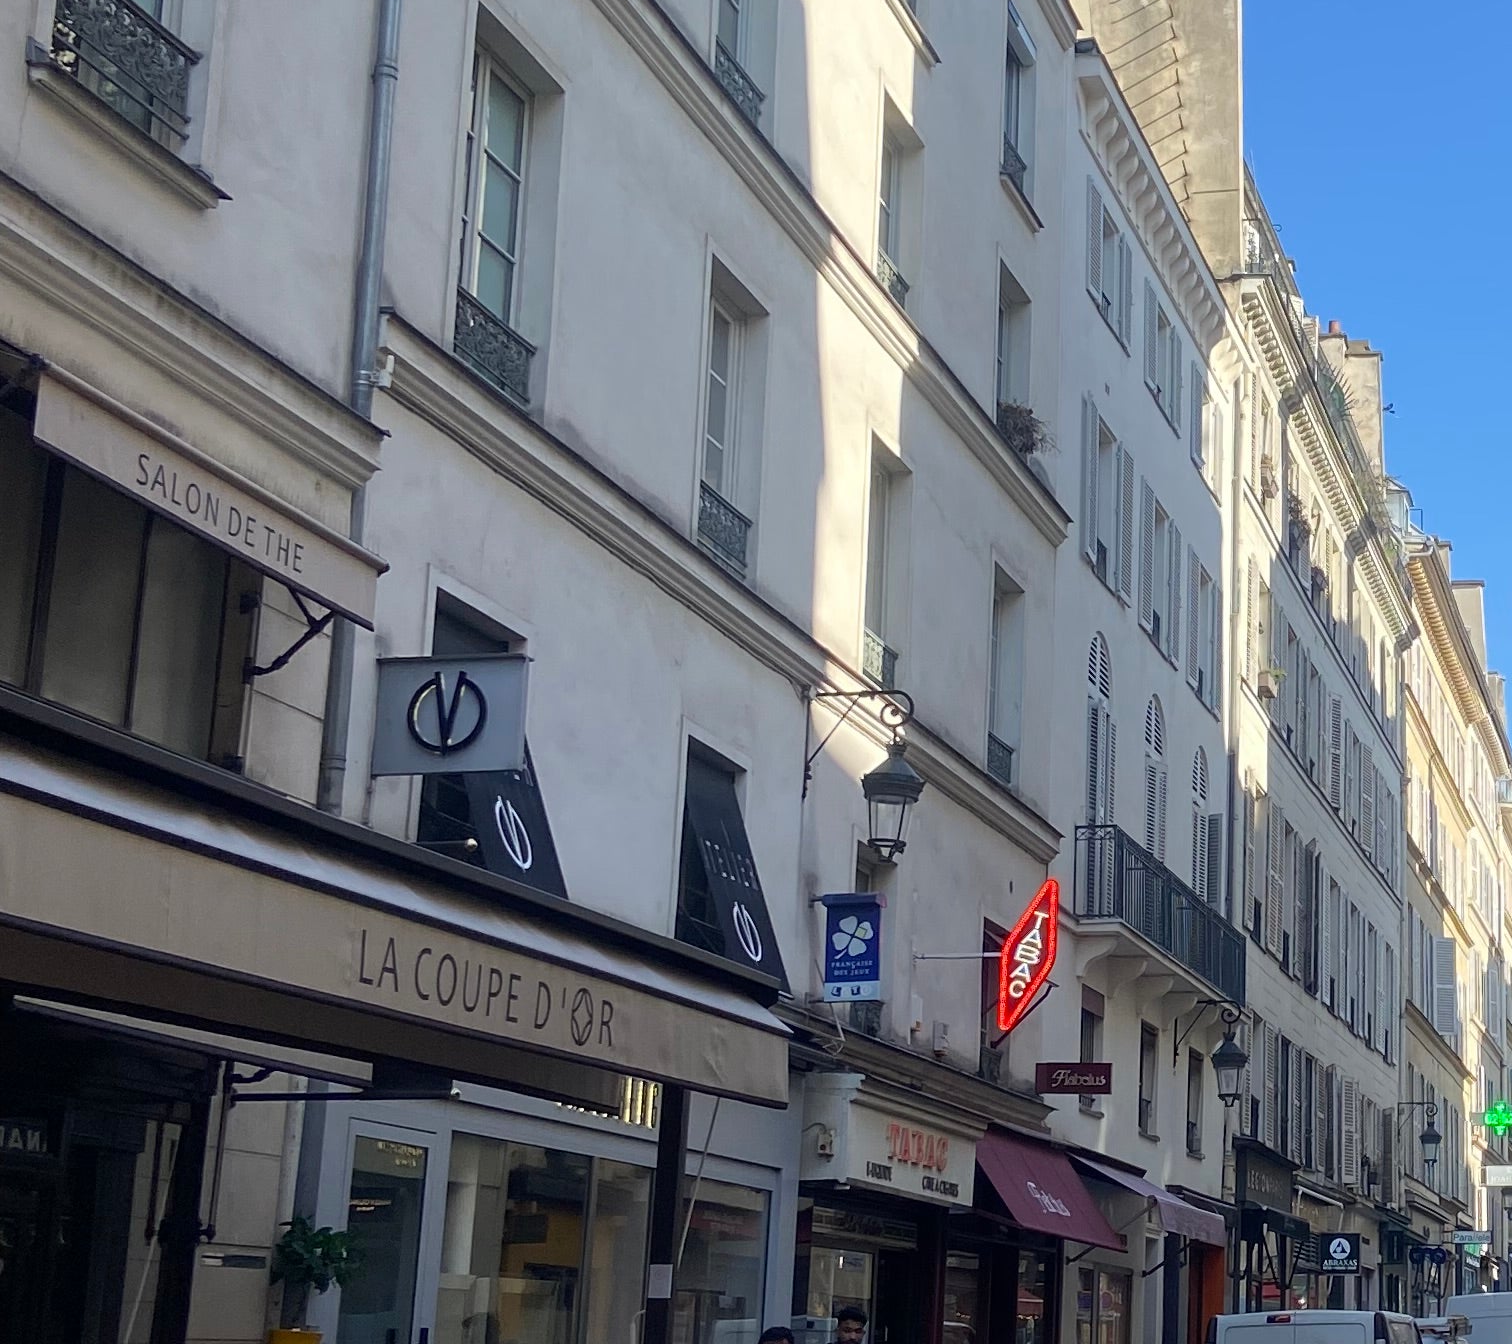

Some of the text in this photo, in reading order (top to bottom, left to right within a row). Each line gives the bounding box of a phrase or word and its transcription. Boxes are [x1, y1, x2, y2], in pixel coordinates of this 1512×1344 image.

[136, 453, 305, 574] SALON DE THE
[358, 928, 400, 993] LA
[413, 947, 523, 1024] COUPE
[1009, 910, 1050, 998] TABAC
[887, 1122, 949, 1173] TABAC
[1323, 1259, 1358, 1267] ABRAXAS
